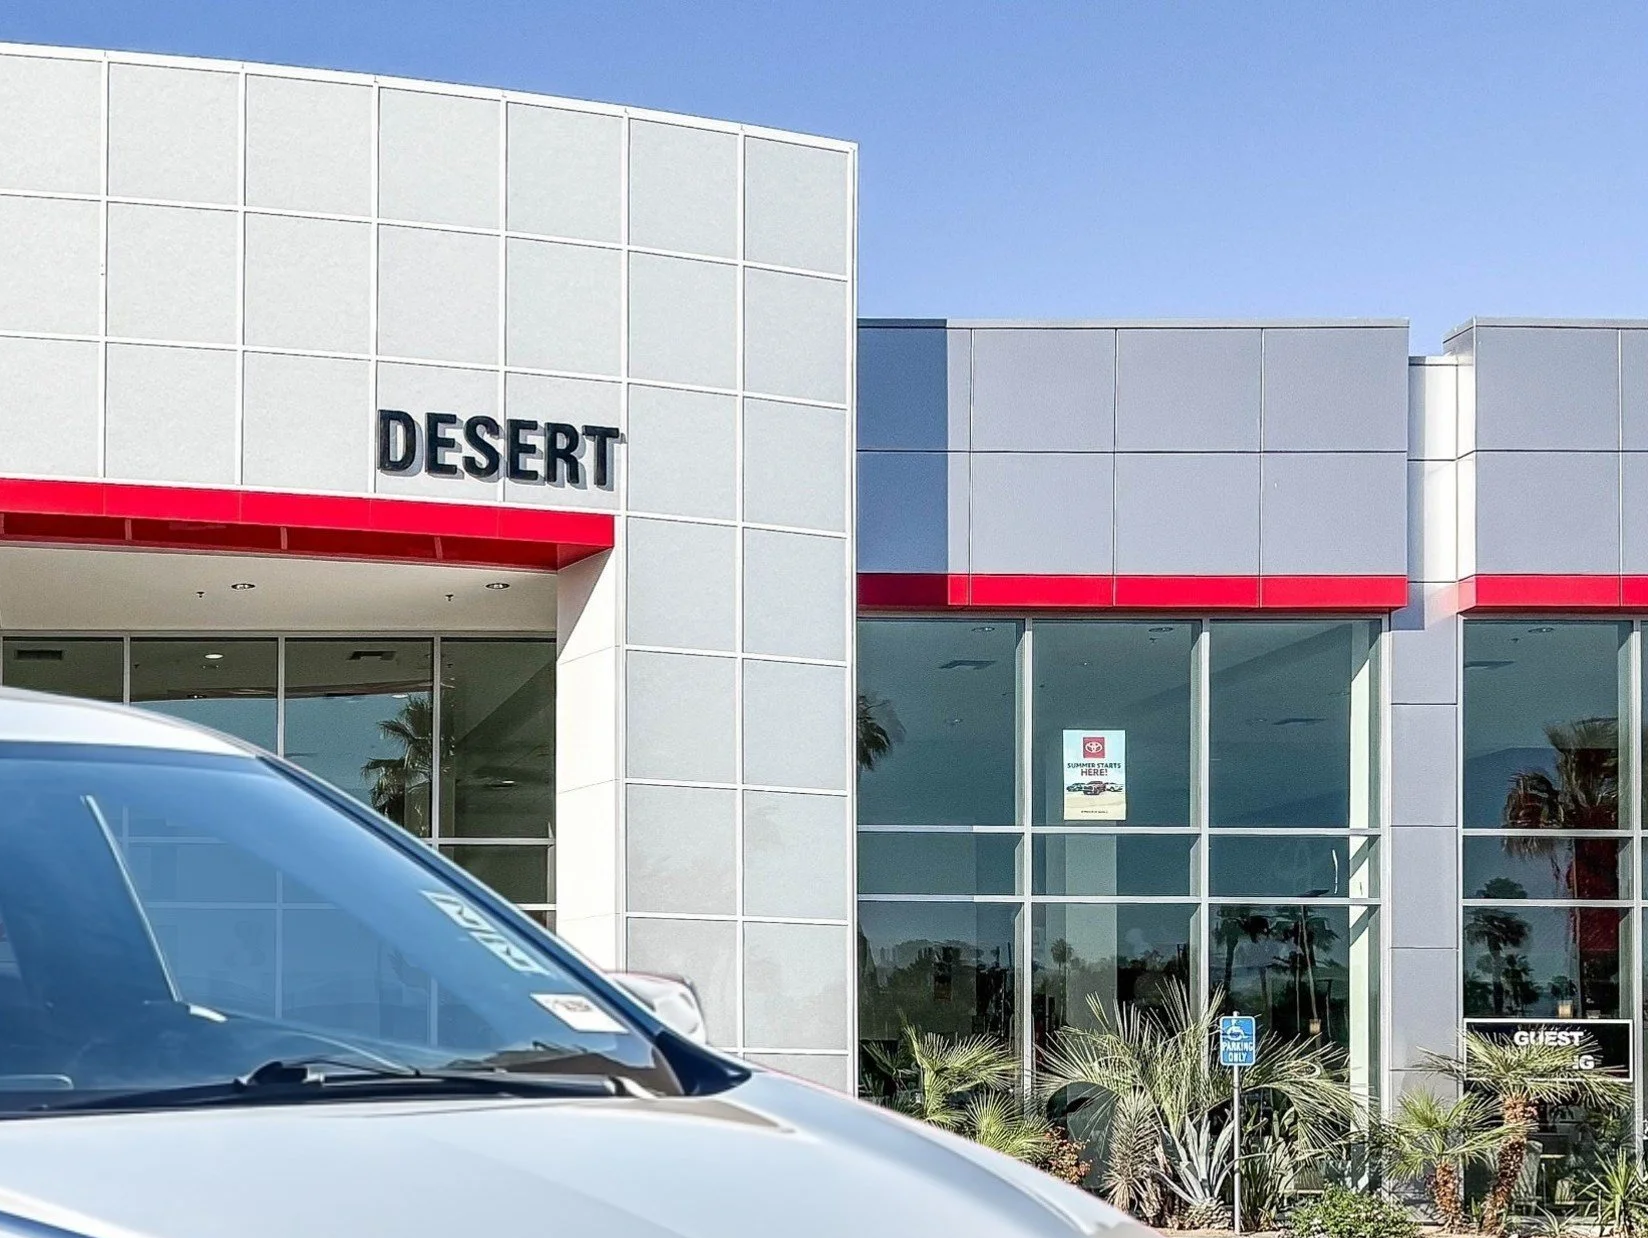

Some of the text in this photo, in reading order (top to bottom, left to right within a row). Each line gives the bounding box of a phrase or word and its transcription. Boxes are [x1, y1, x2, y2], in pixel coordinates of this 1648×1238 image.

[377, 409, 620, 487] DESERT
[1080, 768, 1108, 777] HERE!
[1513, 1030, 1585, 1047] GUEST
[1222, 1041, 1254, 1052] PARKING
[1228, 1051, 1248, 1063] ONLY
